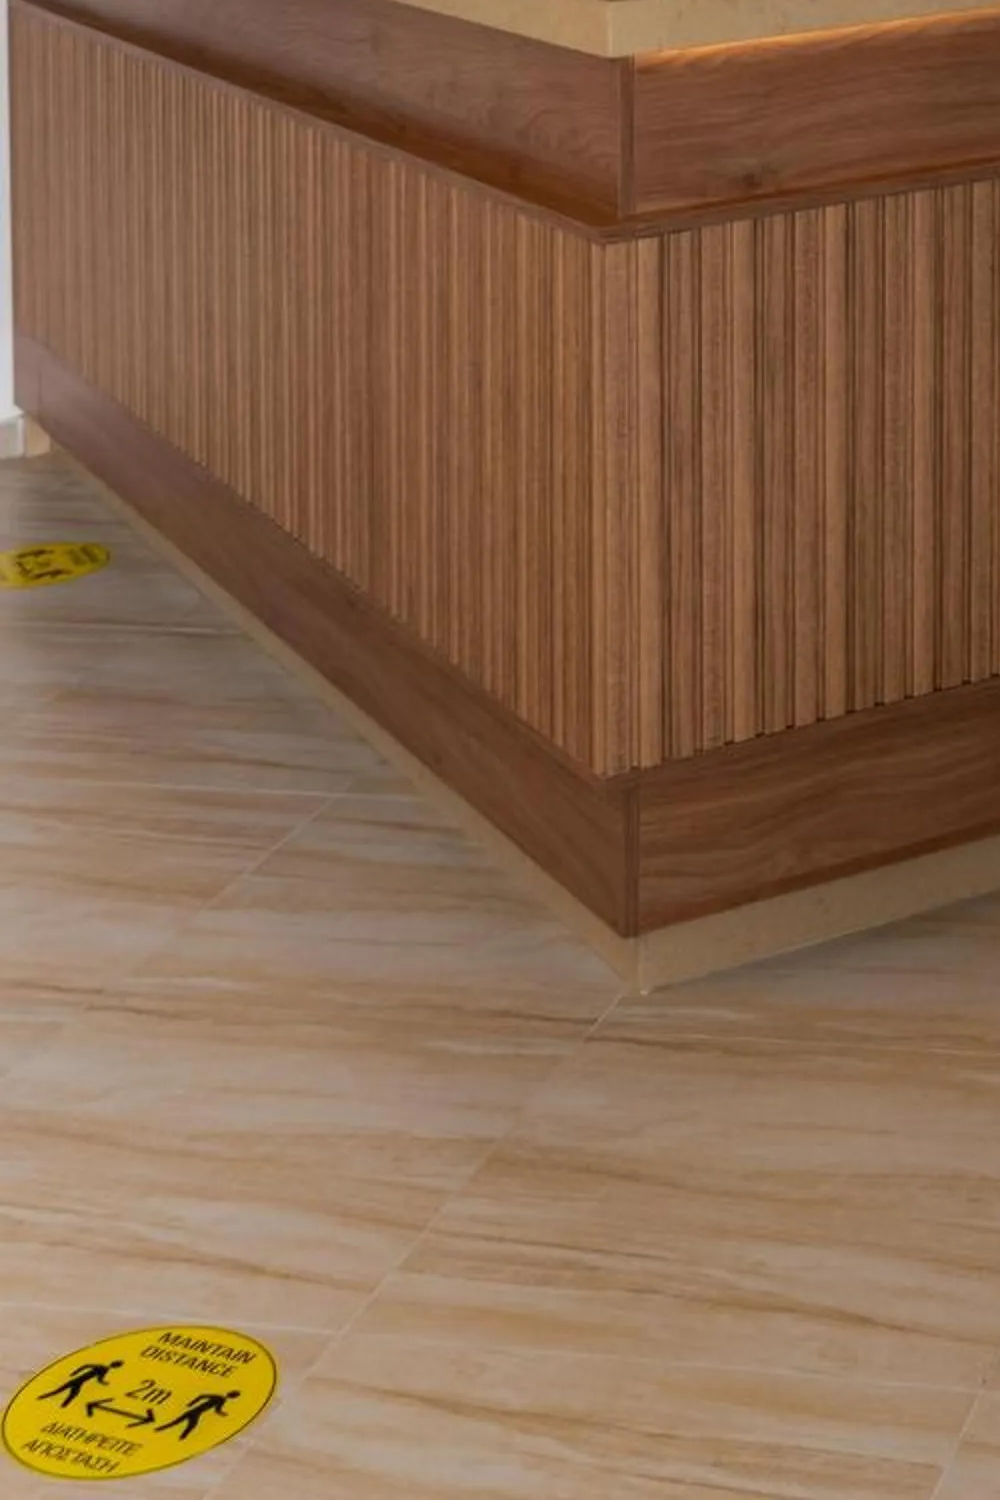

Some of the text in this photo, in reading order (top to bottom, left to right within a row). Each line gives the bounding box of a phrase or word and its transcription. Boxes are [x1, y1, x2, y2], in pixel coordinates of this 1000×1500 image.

[140, 1345, 238, 1378] DISTANCE
[157, 1332, 257, 1365] MAINTAIN
[125, 1379, 173, 1405] 2m
